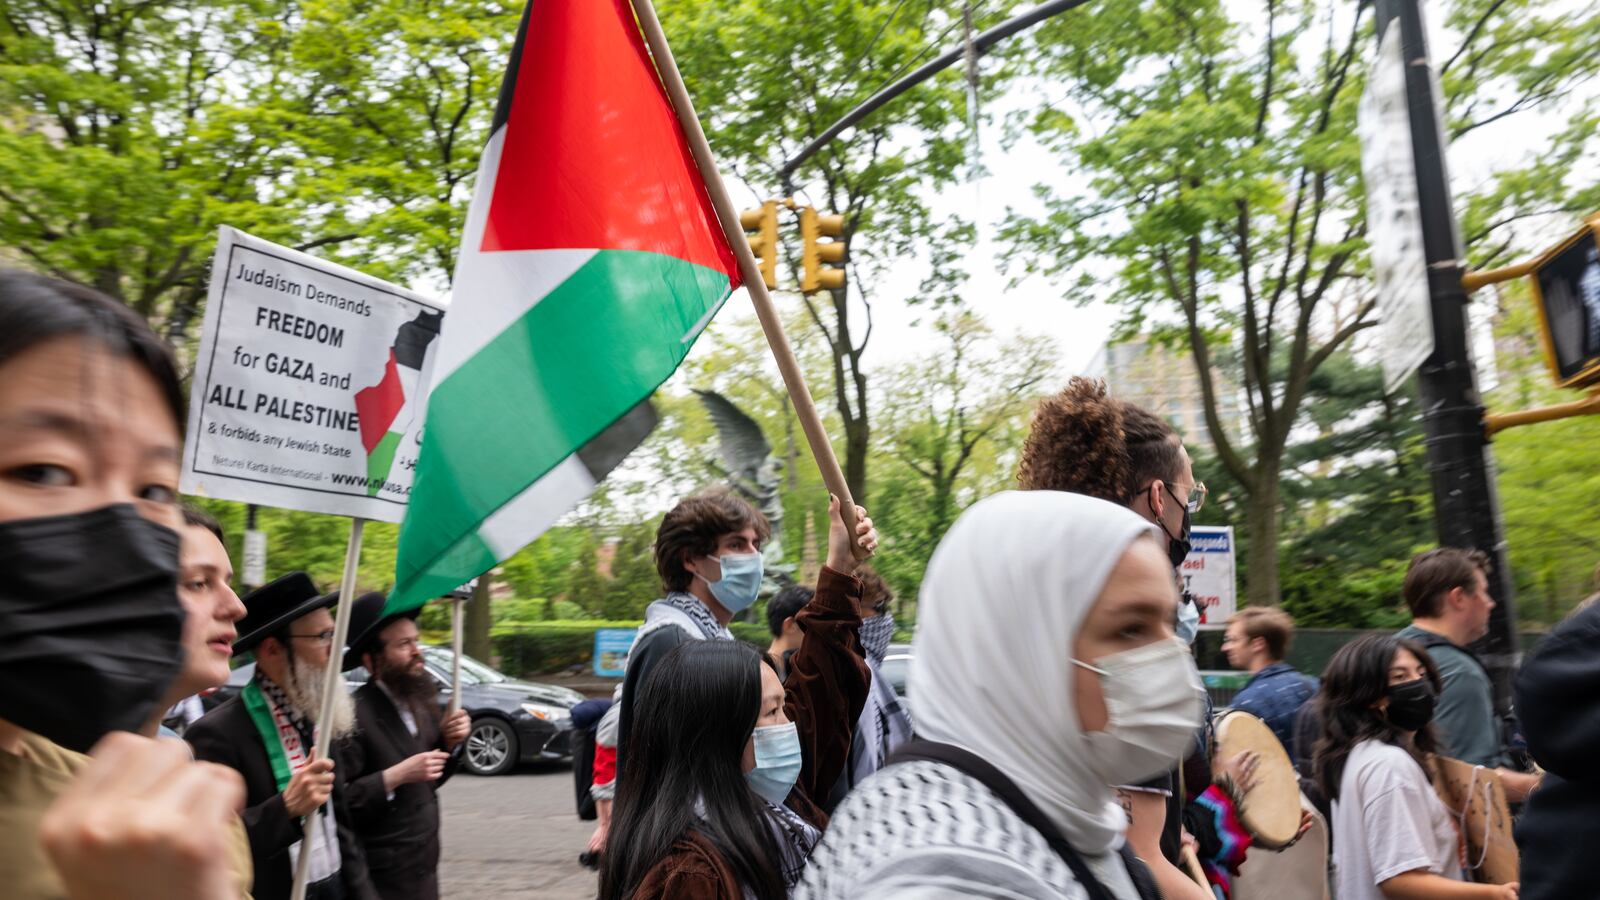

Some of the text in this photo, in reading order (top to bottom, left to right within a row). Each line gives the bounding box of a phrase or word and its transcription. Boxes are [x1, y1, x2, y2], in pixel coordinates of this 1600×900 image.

[236, 264, 372, 317] Judaism Demands
[256, 307, 344, 348] FREEDOM
[233, 346, 351, 391] for GAZA and
[209, 384, 360, 432] ALL PALESTINE
[208, 422, 352, 458] & forbids any Jewish State
[246, 460, 270, 474] Karta
